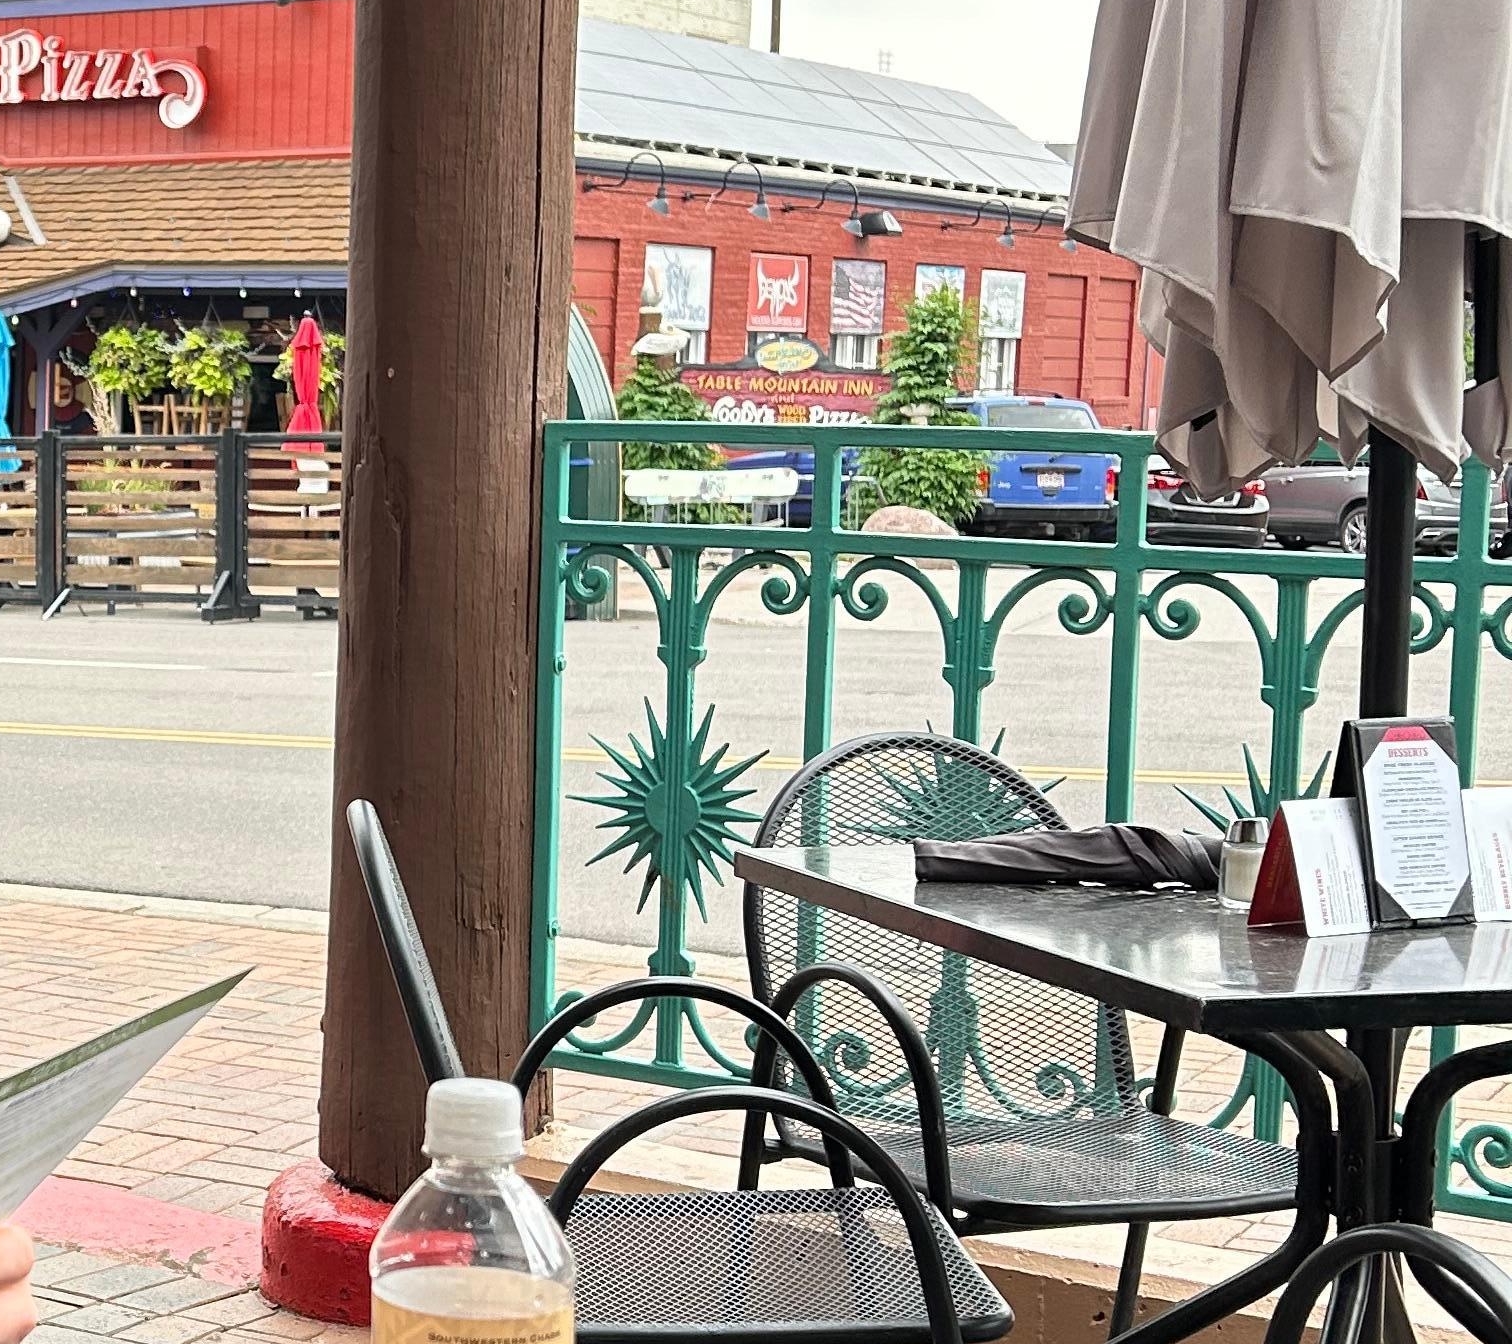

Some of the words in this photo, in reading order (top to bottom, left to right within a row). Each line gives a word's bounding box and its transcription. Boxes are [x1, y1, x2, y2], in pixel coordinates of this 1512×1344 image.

[696, 375, 742, 390] TABLE
[748, 377, 838, 395] MOUNTAIN
[842, 379, 875, 396] INN
[428, 1332, 526, 1344] SOUTHWESTERN
